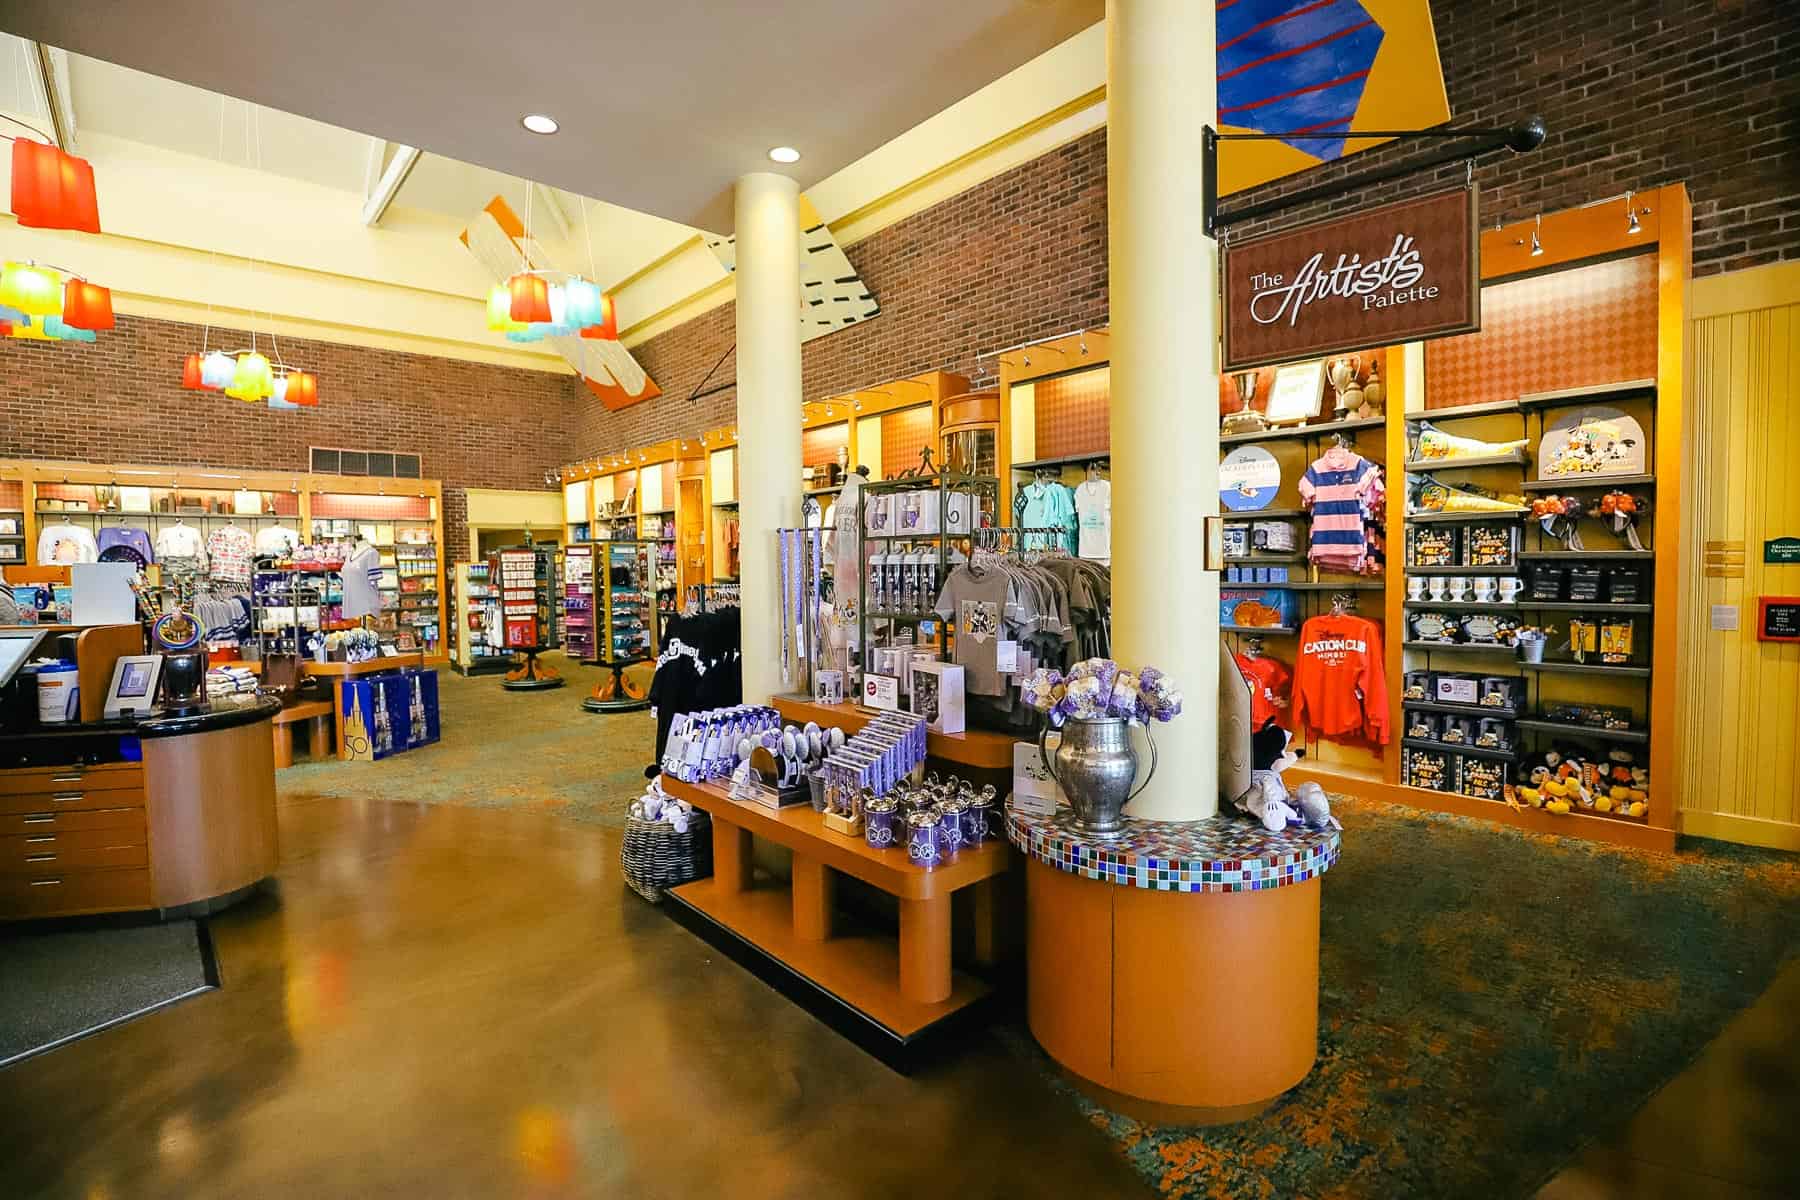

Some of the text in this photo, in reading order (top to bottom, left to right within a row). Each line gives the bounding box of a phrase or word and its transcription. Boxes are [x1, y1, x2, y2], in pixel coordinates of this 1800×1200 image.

[1250, 233, 1424, 328] Artist's
[1250, 272, 1283, 290] The
[1362, 286, 1439, 311] Palette
